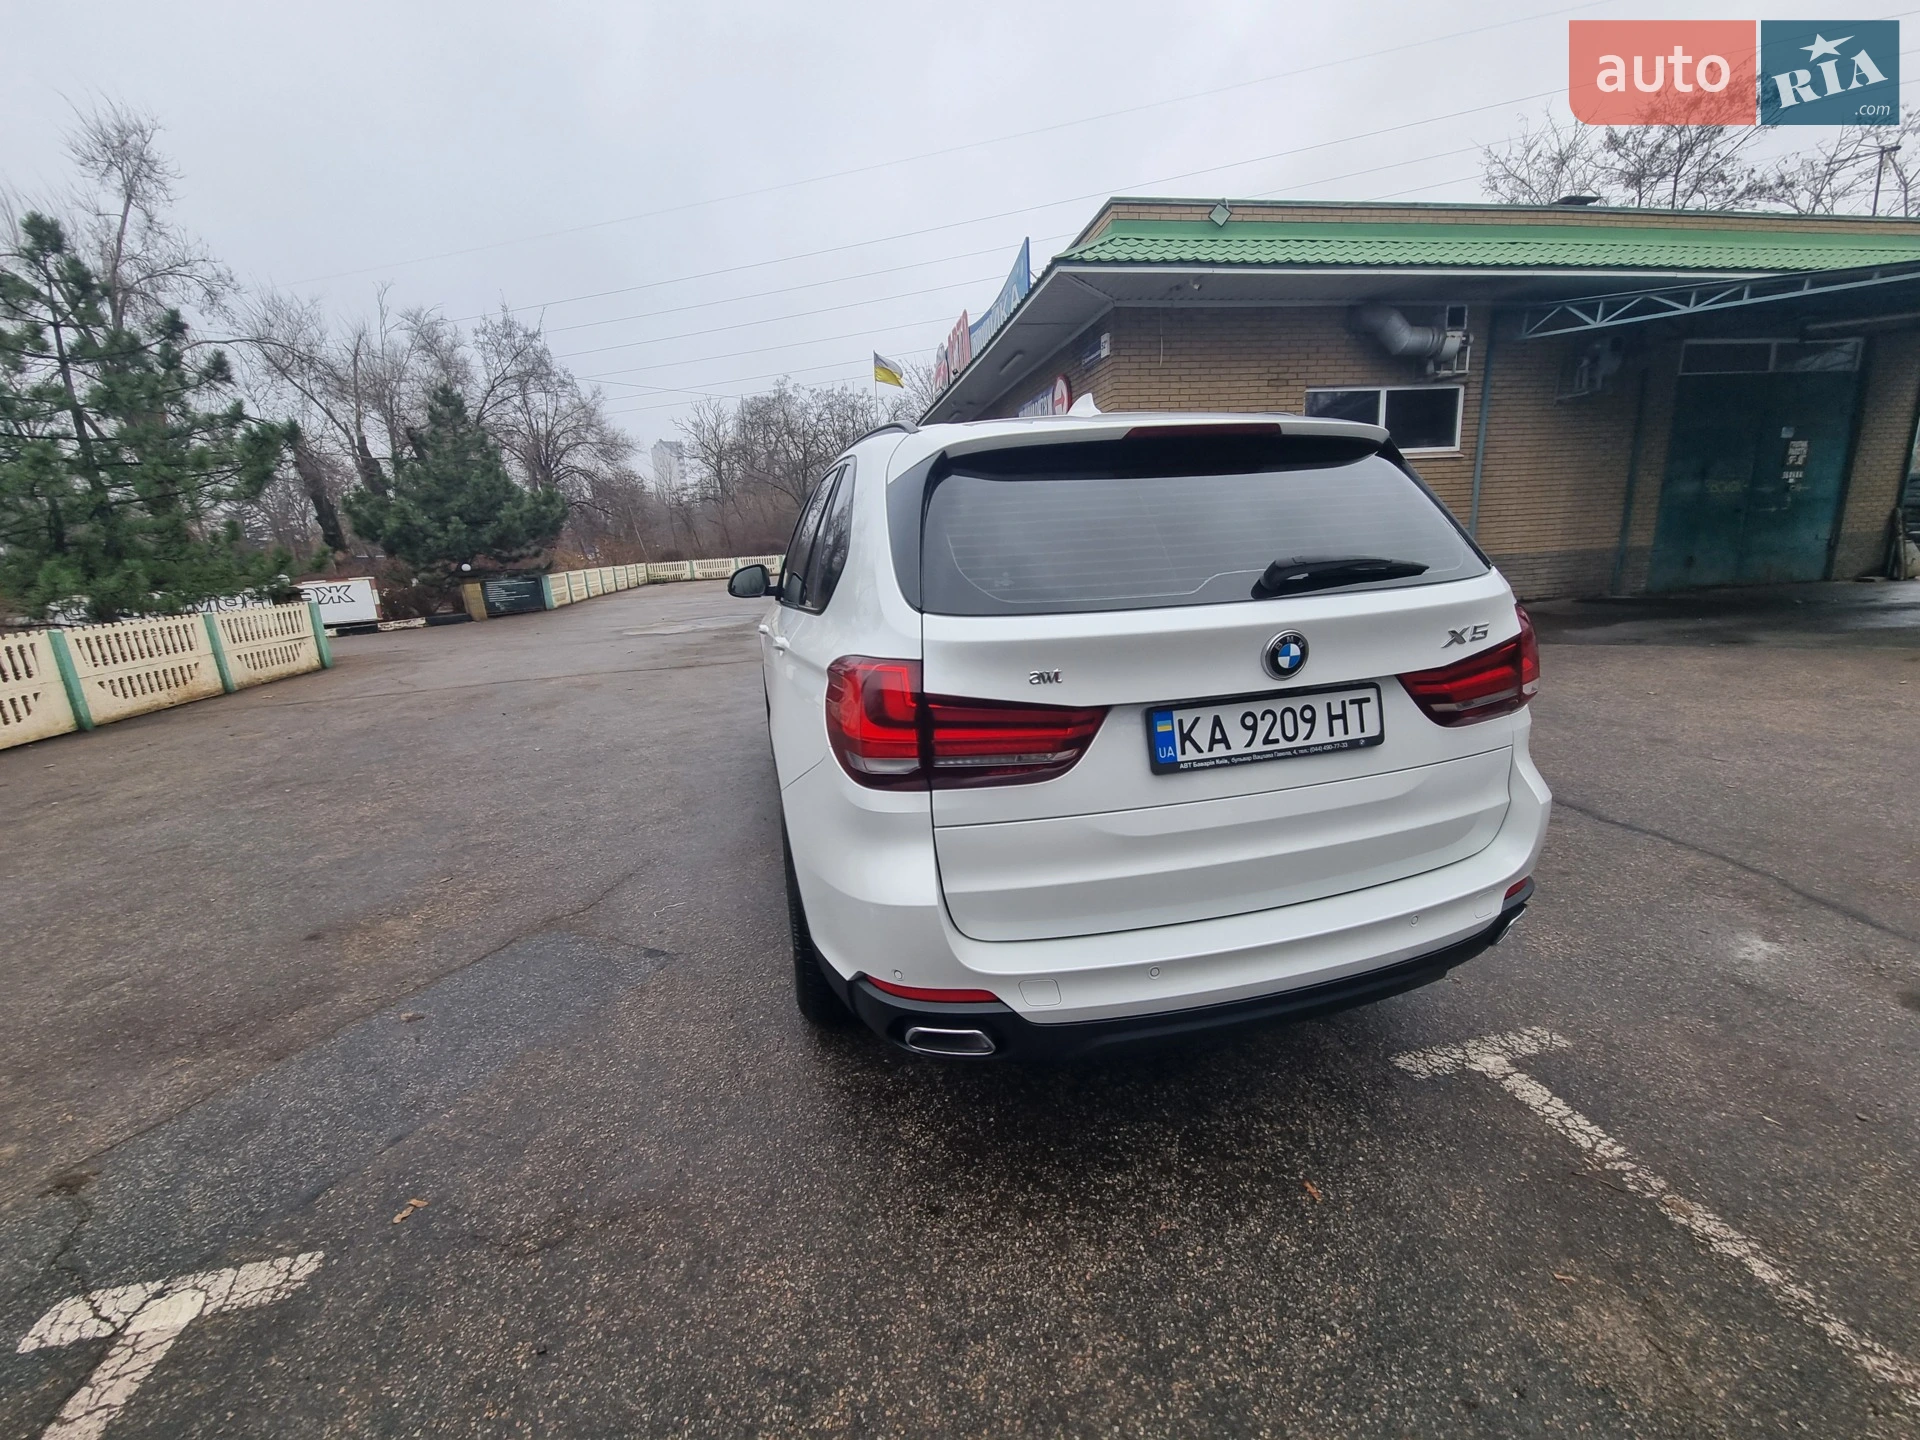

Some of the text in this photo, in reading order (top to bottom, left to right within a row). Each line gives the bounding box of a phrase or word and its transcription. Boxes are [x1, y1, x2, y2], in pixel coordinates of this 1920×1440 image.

[1274, 635, 1305, 650] BMW
[1440, 621, 1490, 648] X5
[1178, 697, 1371, 756] KA 9209 HT
[1158, 745, 1175, 759] UA
